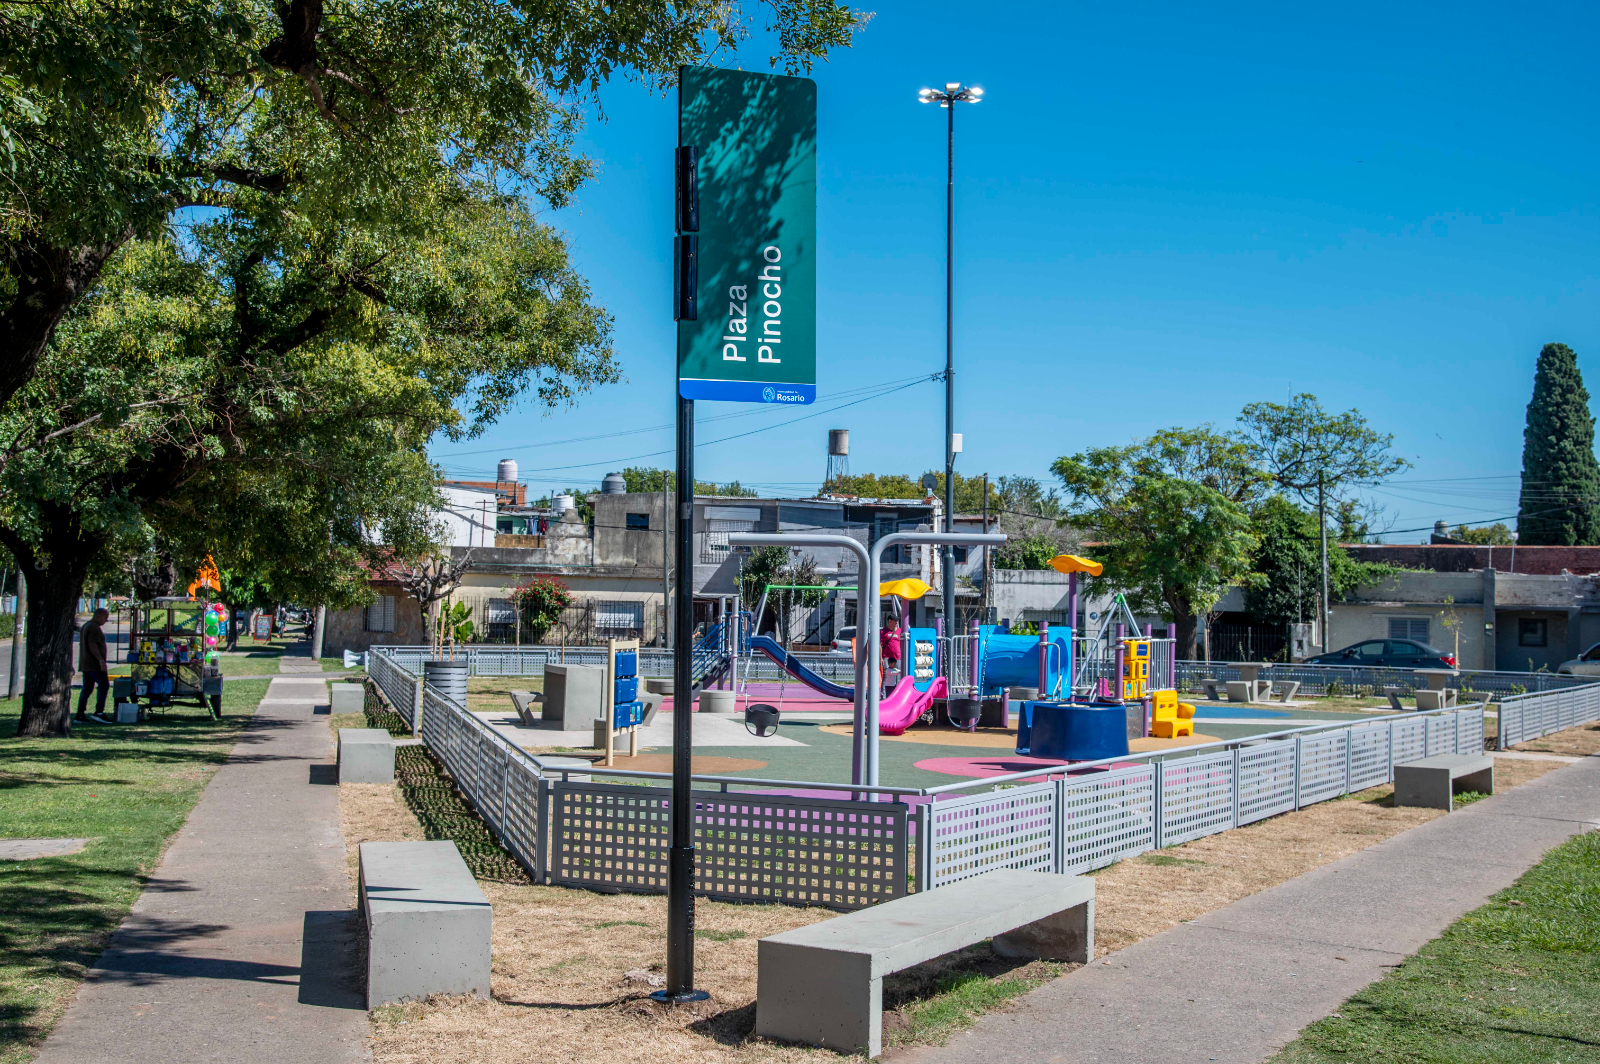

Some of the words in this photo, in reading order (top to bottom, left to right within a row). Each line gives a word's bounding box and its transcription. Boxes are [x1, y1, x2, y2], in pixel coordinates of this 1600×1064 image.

[723, 285, 747, 362] Plaza
[758, 246, 782, 364] Pinocho
[777, 393, 805, 402] Rosario
